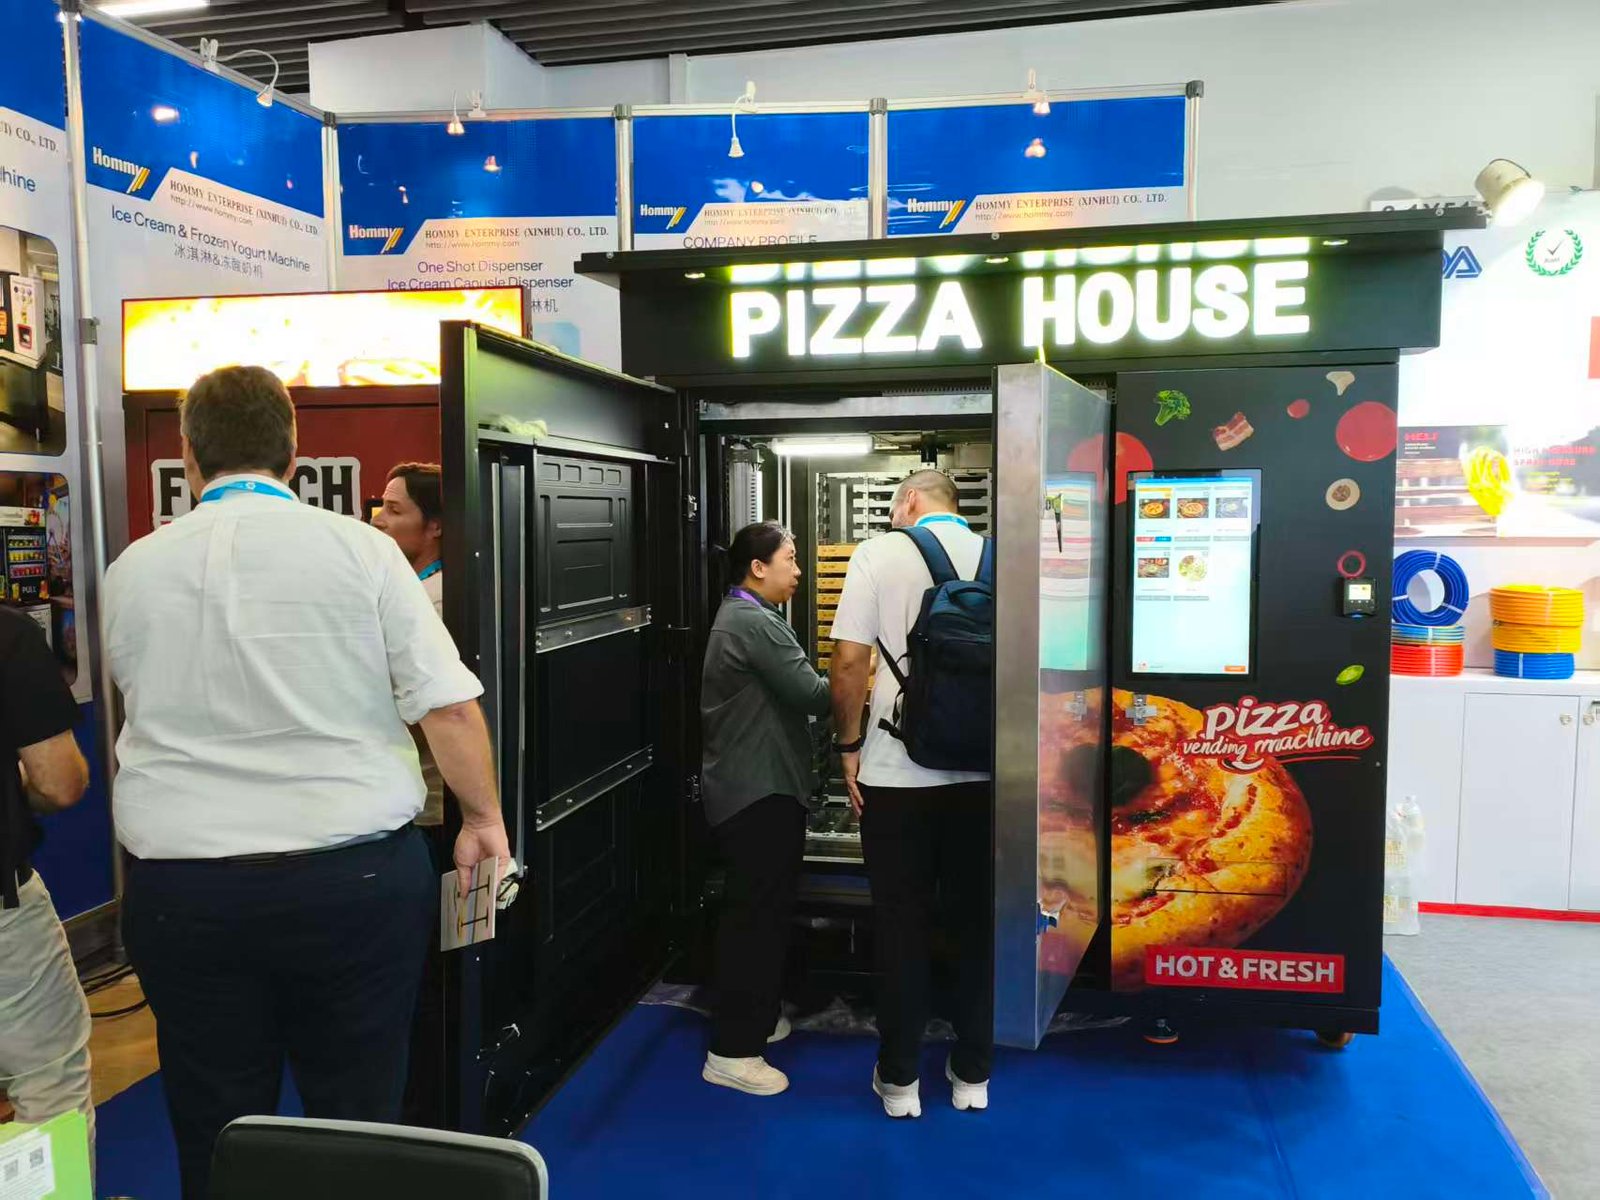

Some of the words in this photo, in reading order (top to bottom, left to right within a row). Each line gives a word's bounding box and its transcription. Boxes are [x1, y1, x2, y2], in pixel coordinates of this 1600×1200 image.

[39, 135, 59, 152] LTD.
[0, 165, 36, 192] hine
[92, 146, 150, 194] Hommy
[170, 180, 204, 199] HOMMY
[208, 191, 254, 216] ENTERPRISE
[704, 208, 734, 217] HOMMY
[907, 197, 966, 229] Hommy
[975, 201, 1012, 211] HOMMY
[1016, 197, 1075, 209] ENTERPRISE
[1078, 194, 1120, 207] (XINHUI)
[1146, 193, 1167, 203] LTD.
[640, 204, 687, 230] Hommy
[111, 205, 132, 223] Ice
[134, 211, 176, 235] Cream
[178, 224, 188, 238] &
[190, 227, 230, 249] Frozen
[231, 239, 267, 260] Yogurt
[268, 250, 311, 272] Machine
[349, 224, 404, 254] Hommy
[425, 229, 460, 239] HOMMY
[465, 228, 520, 238] ENTERPRISE
[524, 226, 564, 238] (XINHUI)
[589, 226, 609, 237] LTD.
[683, 235, 755, 250] COMPANY
[759, 234, 818, 246] PROFILE
[417, 261, 444, 273] One
[446, 260, 476, 272] Shot
[478, 260, 544, 274] Dispenser
[387, 279, 406, 289] Ice
[409, 278, 451, 289] Cream
[508, 276, 575, 289] Dispenser
[731, 280, 985, 359] PIZZA
[1021, 259, 1311, 348] HOUSE
[158, 464, 355, 517] FCH
[1205, 698, 1328, 741] pizza
[1183, 736, 1248, 761] vending
[1254, 724, 1371, 754] machine
[1155, 954, 1218, 978] HOT
[1218, 957, 1239, 980] &
[1242, 959, 1336, 984] FRESH
